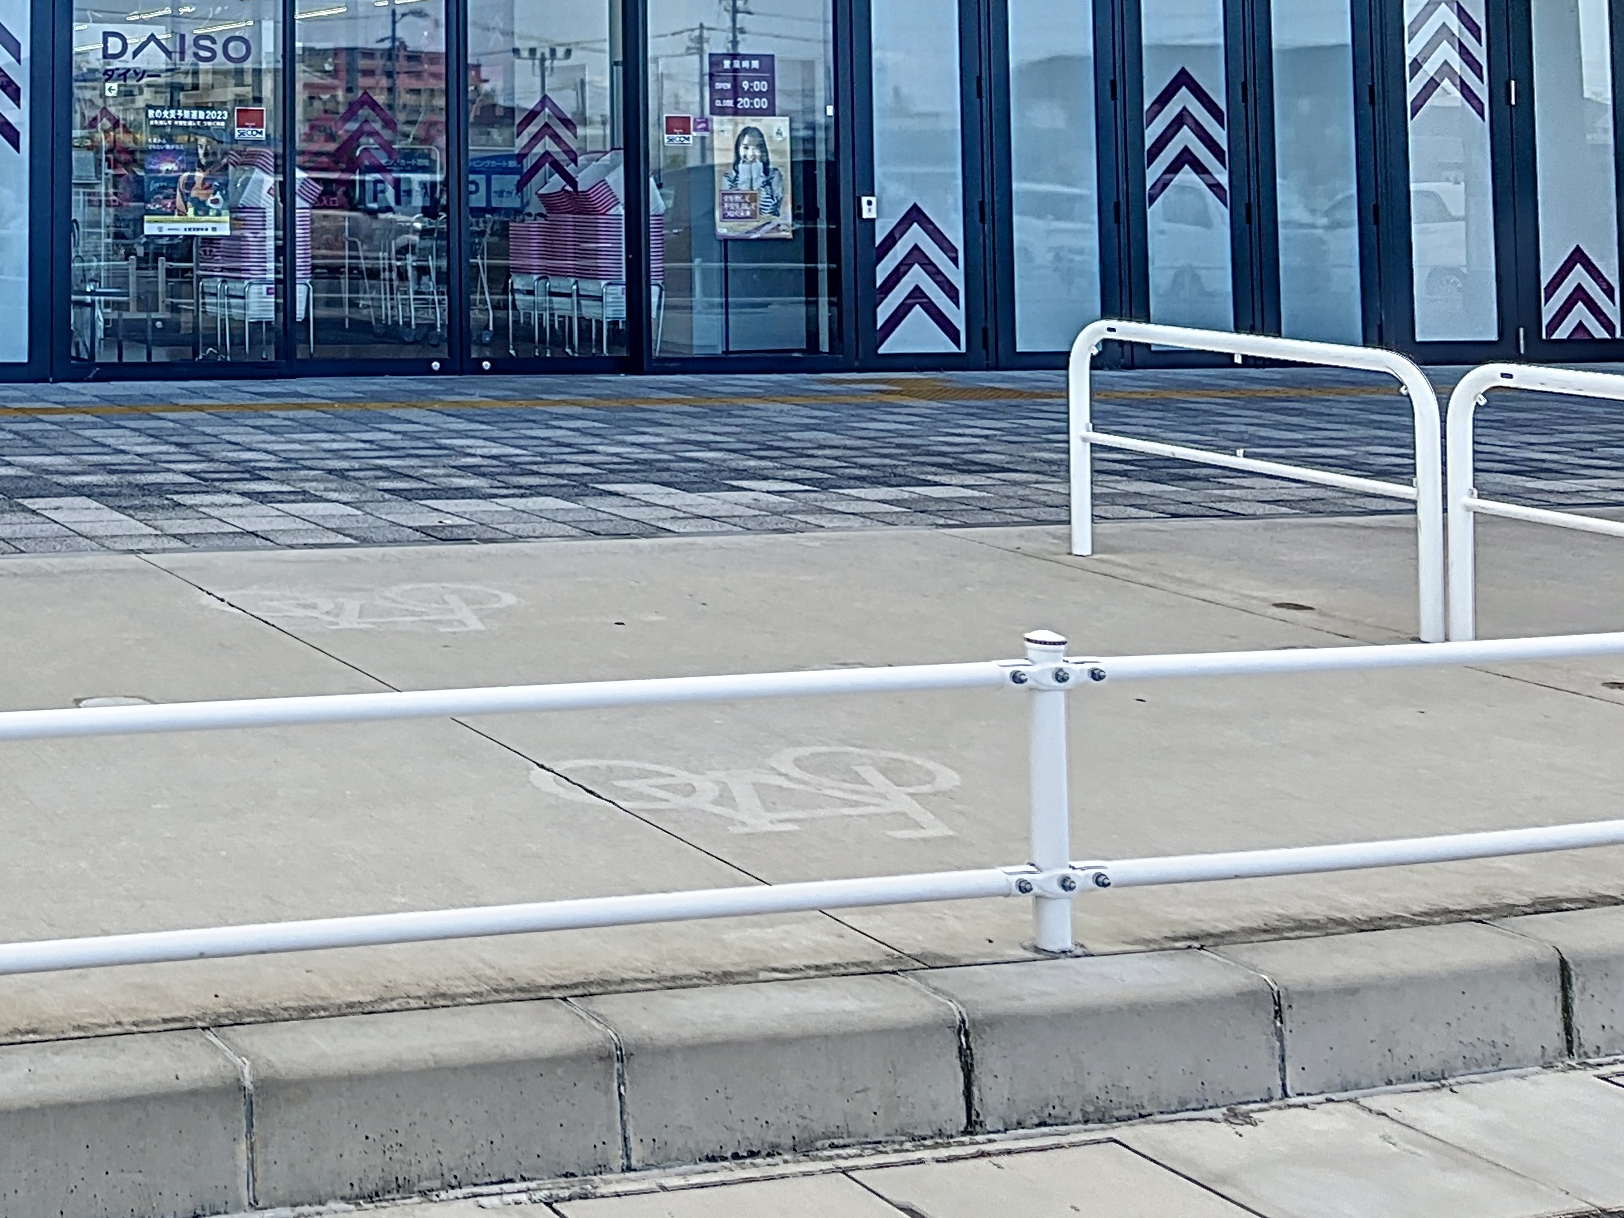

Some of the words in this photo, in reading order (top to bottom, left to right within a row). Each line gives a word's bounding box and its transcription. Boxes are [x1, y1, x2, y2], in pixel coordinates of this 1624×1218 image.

[102, 31, 252, 64] DAISO
[102, 68, 162, 82] ダイソー
[715, 82, 731, 90] OPEN
[742, 80, 768, 92] 9:00
[715, 99, 734, 107] CLOSE
[737, 97, 768, 109] 20:00
[237, 129, 263, 137] SECOM
[666, 136, 691, 144] SECOM
